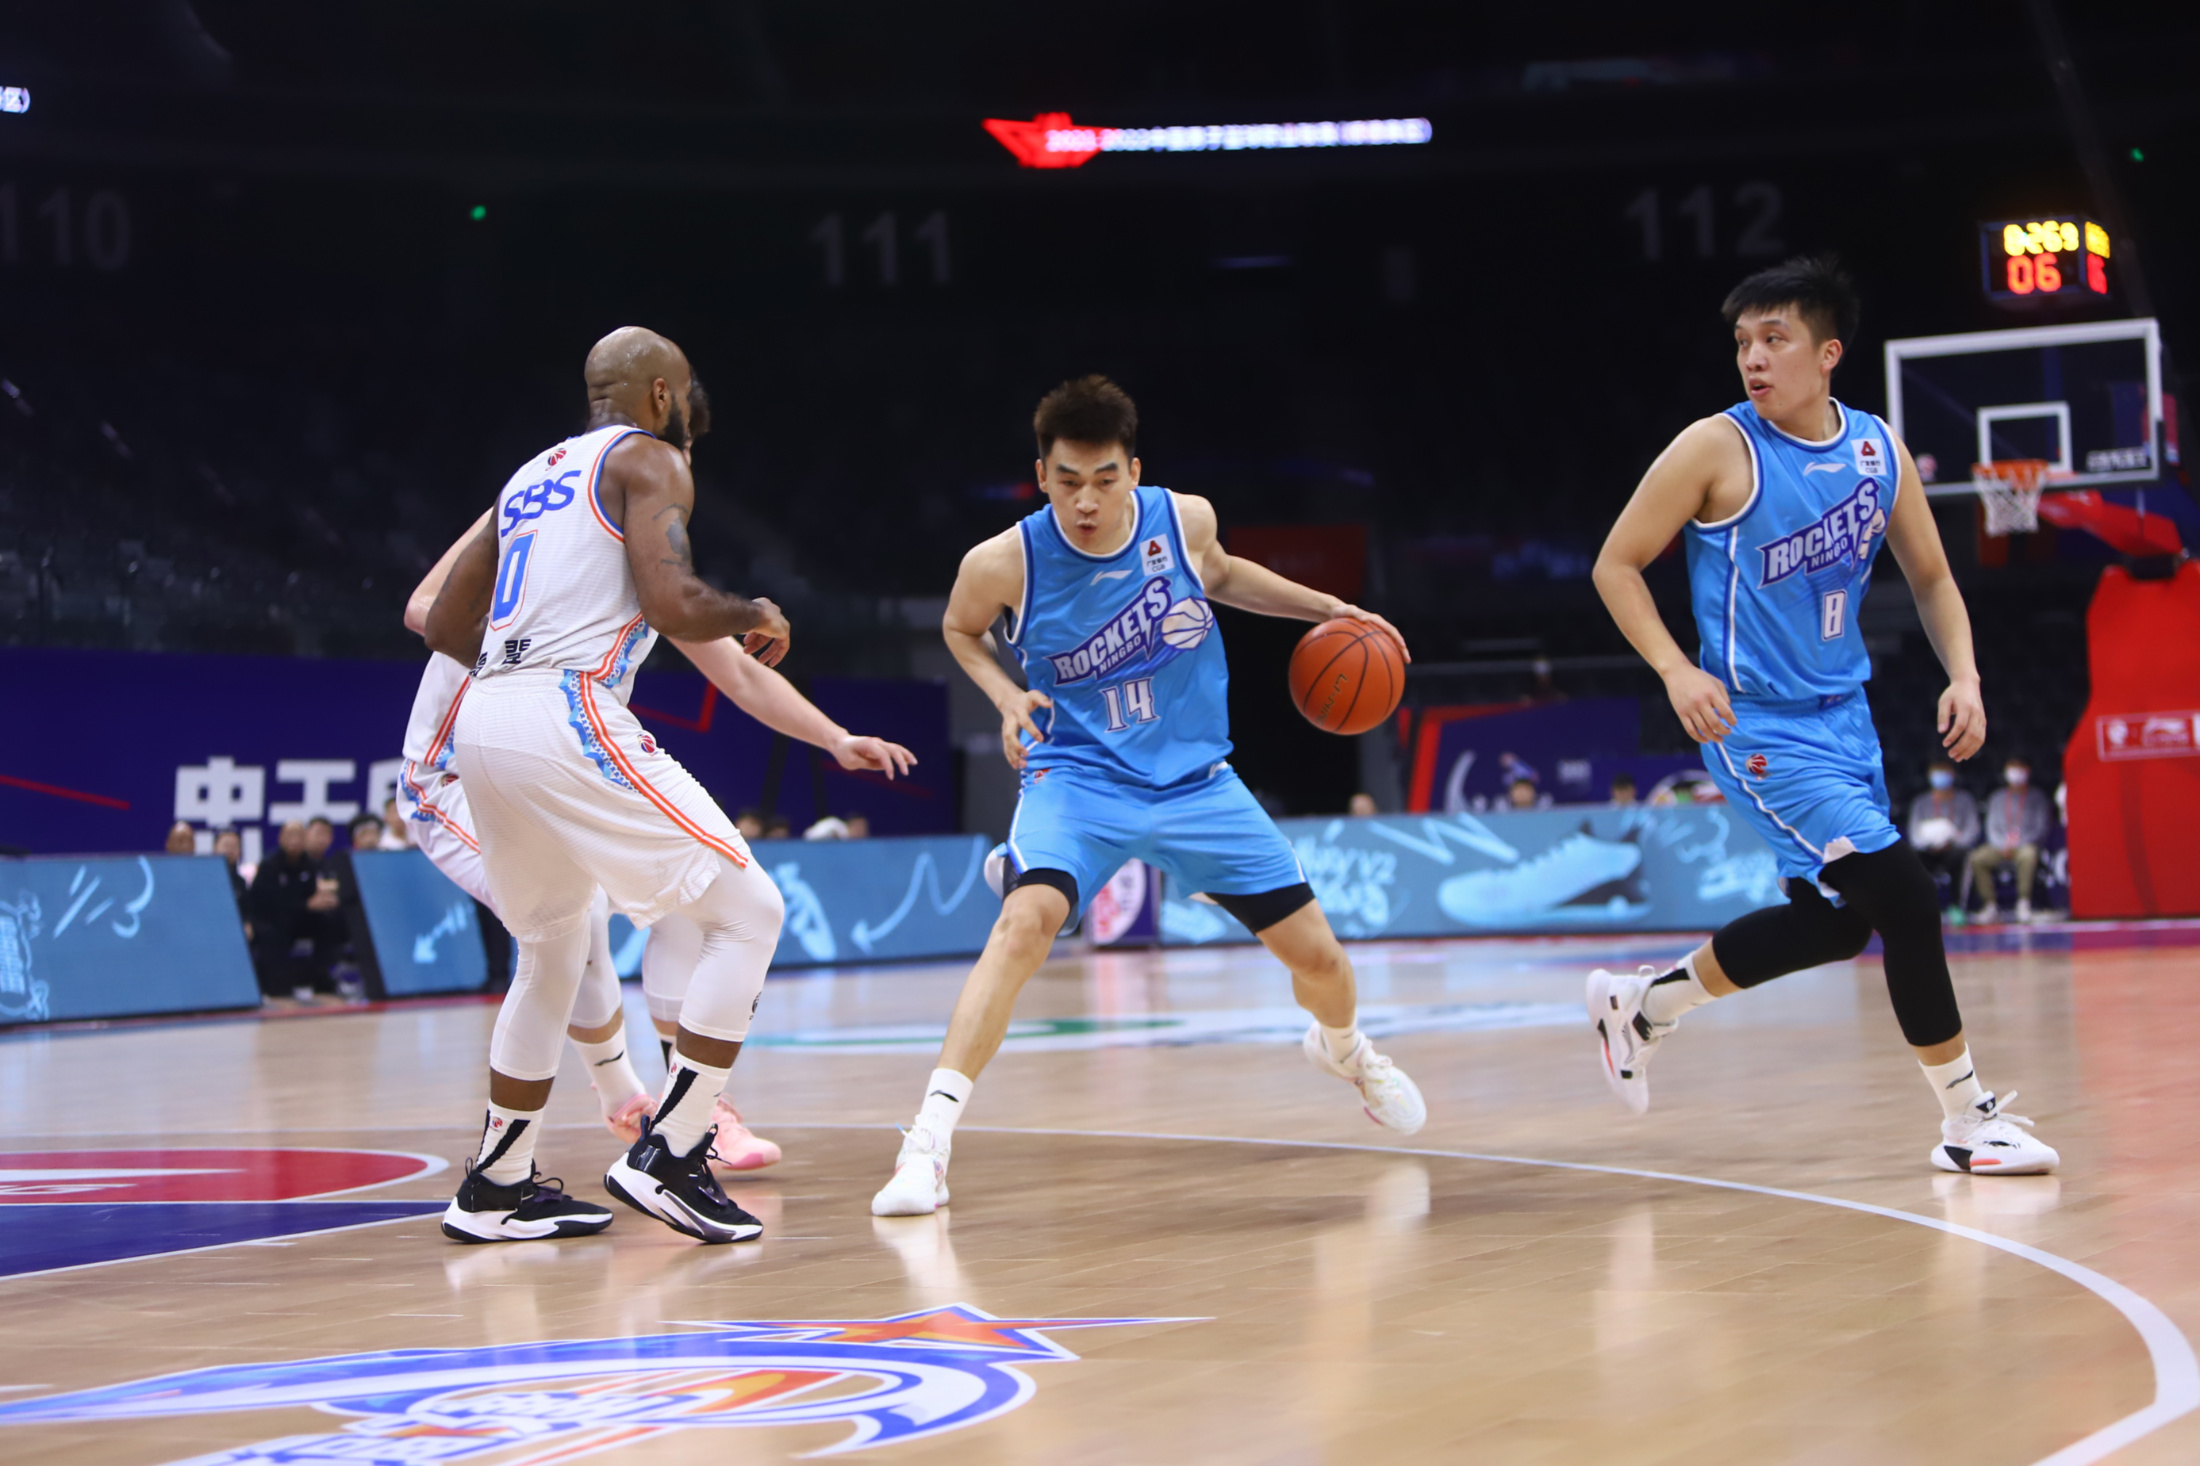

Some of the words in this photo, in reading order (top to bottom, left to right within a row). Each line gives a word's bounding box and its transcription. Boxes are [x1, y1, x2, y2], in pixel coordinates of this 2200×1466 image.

[0, 183, 130, 269] 110
[810, 210, 951, 287] 111
[1625, 180, 1786, 261] 112
[2007, 252, 2062, 295] 06
[500, 470, 582, 537] SBS
[1766, 480, 1877, 581] ROCKETS
[490, 529, 538, 631] 0
[1822, 588, 1847, 641] 8
[1053, 578, 1170, 680] ROCKETS
[1099, 634, 1142, 674] NINGBO
[1098, 676, 1161, 732] 14
